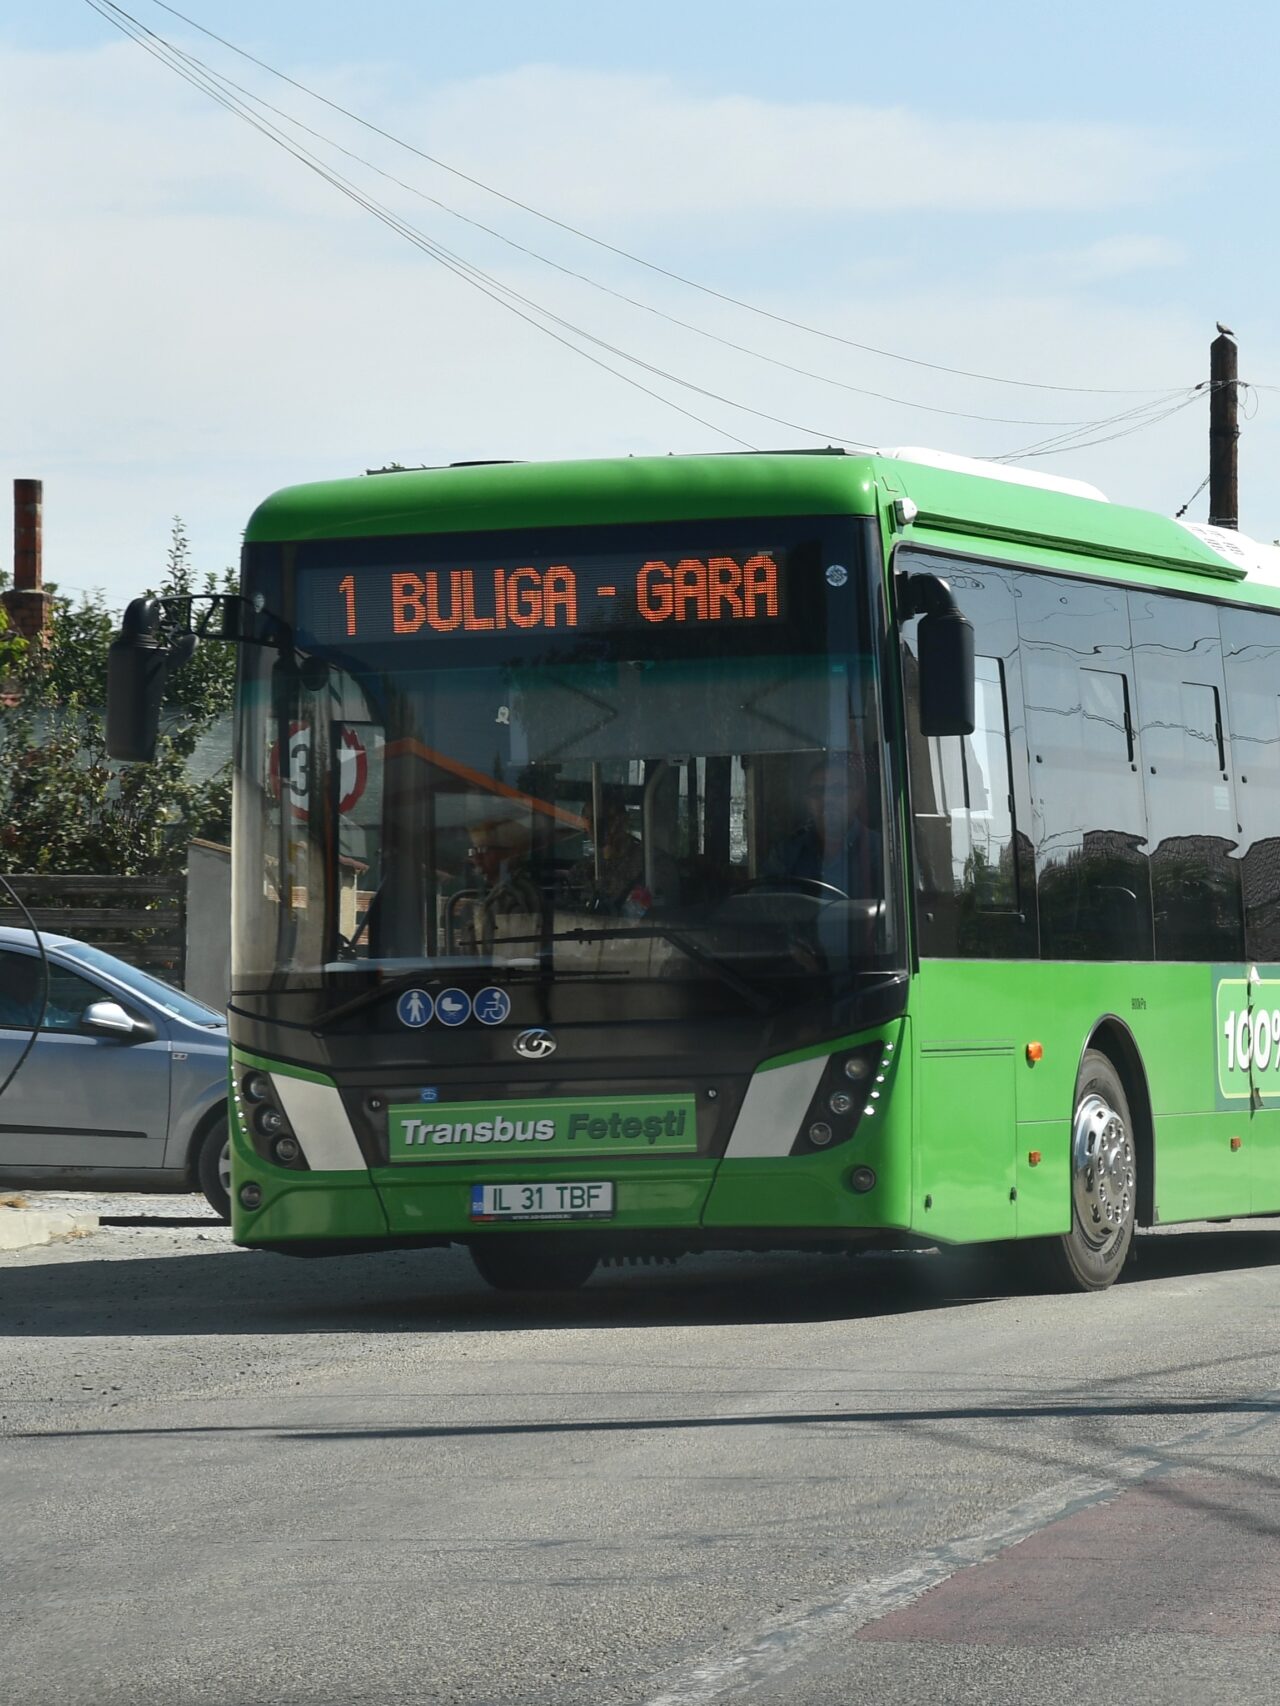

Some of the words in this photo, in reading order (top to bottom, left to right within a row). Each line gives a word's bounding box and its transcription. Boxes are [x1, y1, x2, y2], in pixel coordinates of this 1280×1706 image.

[338, 575, 356, 636] 1
[391, 565, 577, 634] BULIGA
[596, 585, 616, 596] -
[401, 1115, 556, 1146] Transbus
[567, 1108, 687, 1145] Fetești
[493, 1187, 511, 1211] IL
[520, 1186, 543, 1210] 31
[556, 1185, 602, 1209] TBF
